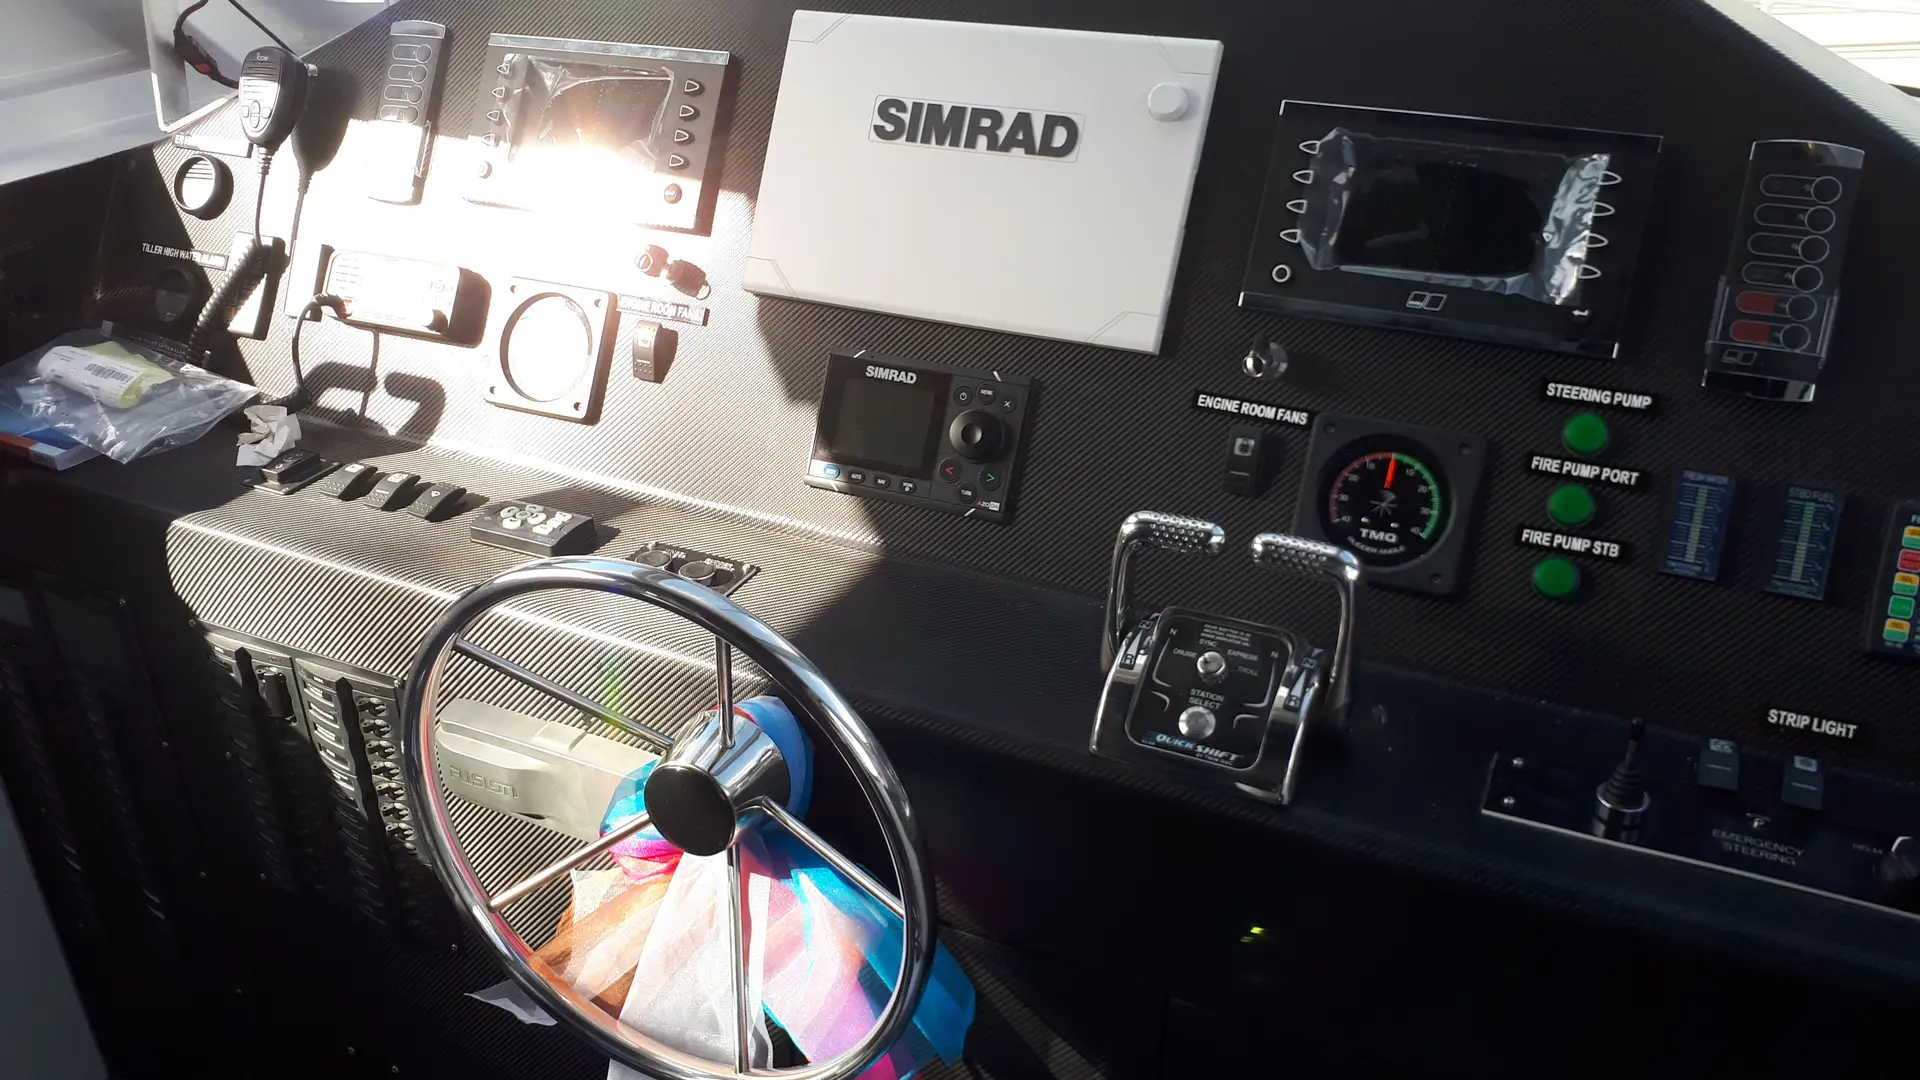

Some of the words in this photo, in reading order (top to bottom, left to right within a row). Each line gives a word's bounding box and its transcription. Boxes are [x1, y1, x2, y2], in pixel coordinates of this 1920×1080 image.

[873, 98, 1079, 158] SIMRAD
[142, 242, 163, 255] TILLER
[162, 246, 180, 259] HIGH
[865, 365, 917, 384] SIMRAD
[1546, 382, 1612, 405] STEERING
[1612, 391, 1652, 409] PUMP
[1197, 394, 1241, 413] ENGINE
[1240, 402, 1277, 420] ROOM
[1276, 408, 1309, 425] FANS
[1347, 473, 1359, 483] 20
[1531, 455, 1562, 473] FIRE
[1562, 460, 1600, 479] PUMP
[1600, 467, 1640, 486] PORT
[1521, 528, 1553, 546] FIRE
[1552, 533, 1592, 553] PUMP
[1592, 540, 1620, 558] STB
[1172, 647, 1198, 659] CRUISE
[1199, 637, 1218, 648] SYNC
[1226, 648, 1259, 662] EXPRESS
[1236, 665, 1259, 677] TROLL
[1188, 696, 1221, 710] SELECT
[1190, 687, 1225, 702] STATION
[1767, 708, 1811, 730] STRIP
[1811, 718, 1858, 739] LIGHT
[448, 764, 520, 799] FUSION
[1712, 828, 1805, 857] EMERGENCY
[1722, 841, 1797, 866] STEERING
